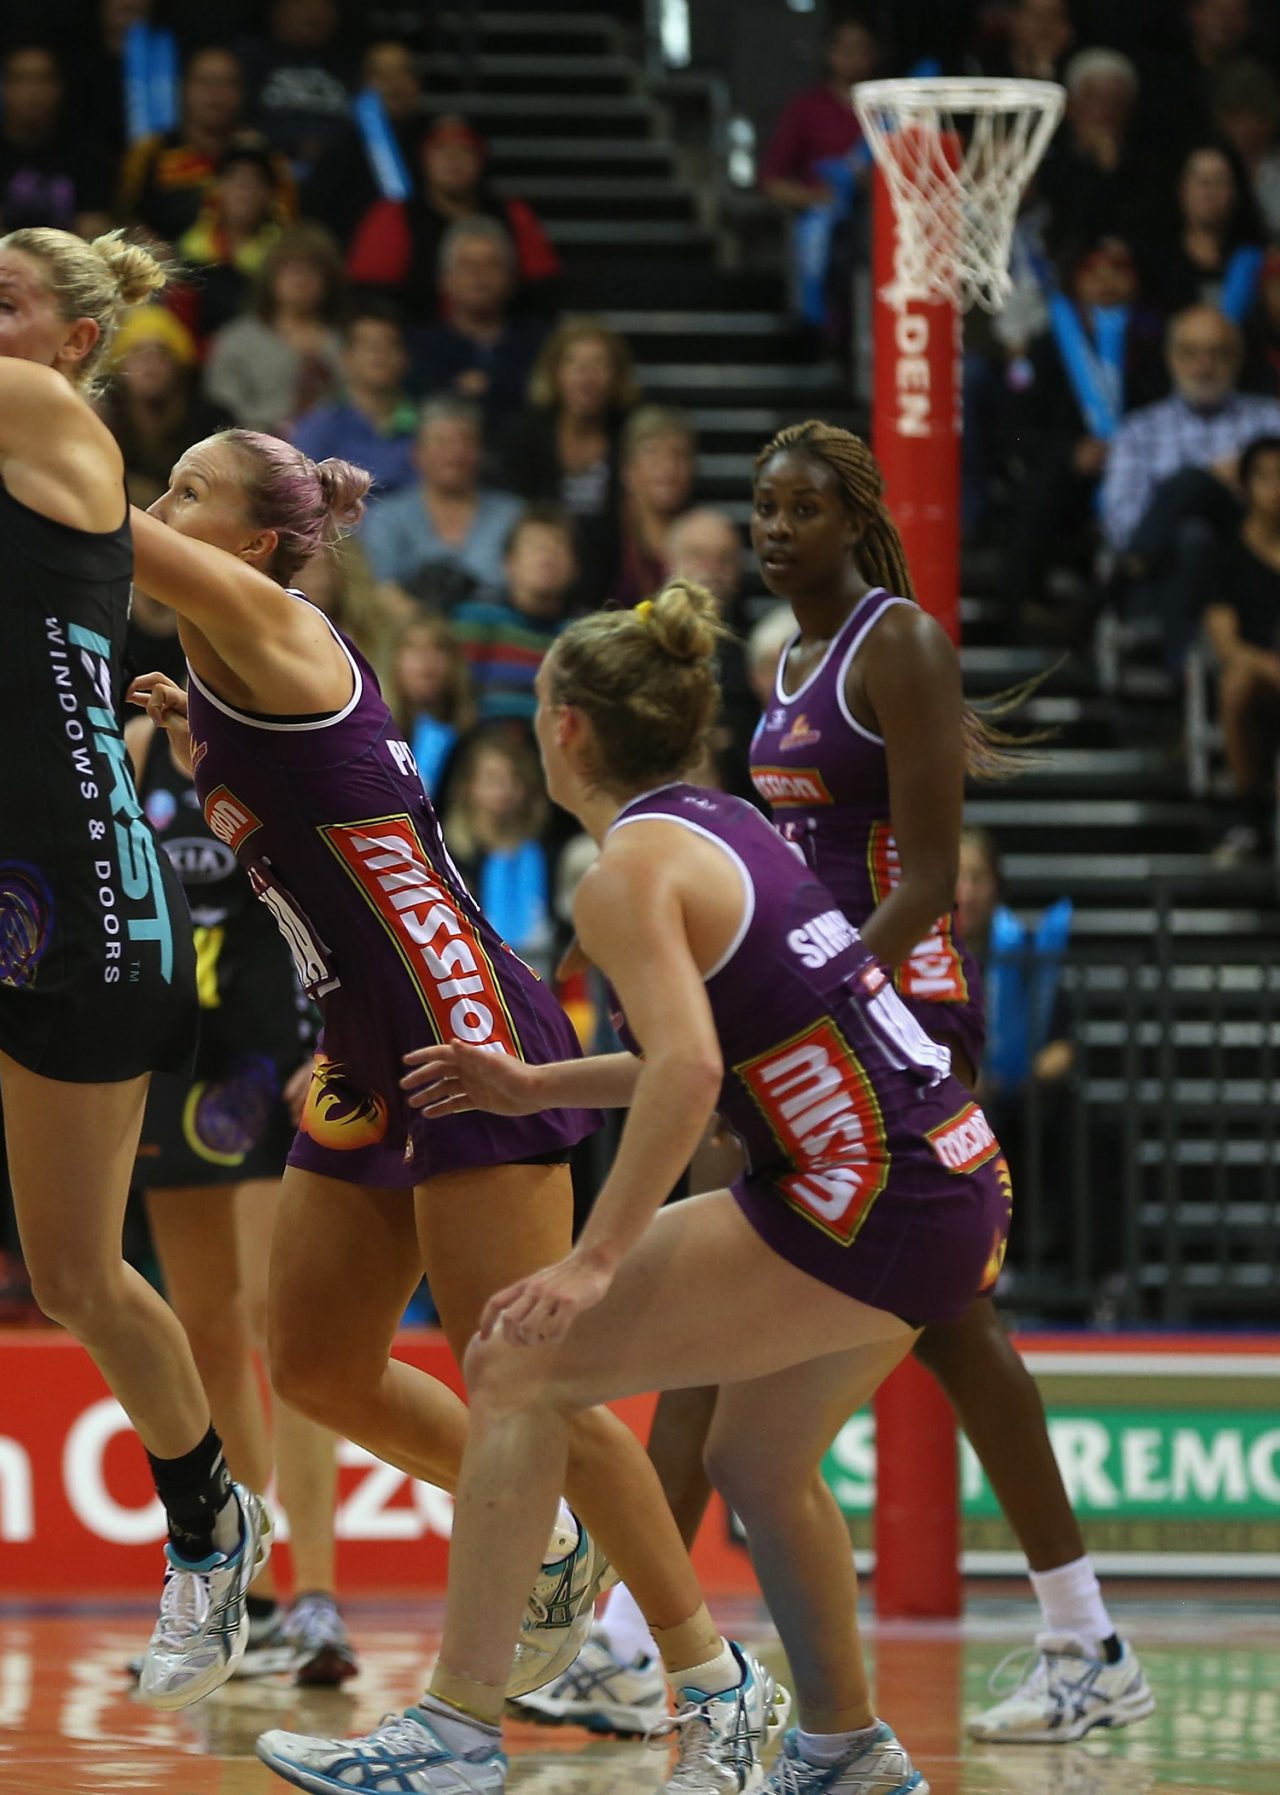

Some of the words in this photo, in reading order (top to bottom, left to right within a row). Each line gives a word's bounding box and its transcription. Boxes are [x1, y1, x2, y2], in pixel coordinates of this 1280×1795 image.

[45, 617, 99, 800] WINDOWS
[67, 622, 173, 985] FIRST
[87, 818, 106, 841] &
[94, 860, 122, 984] DOORS
